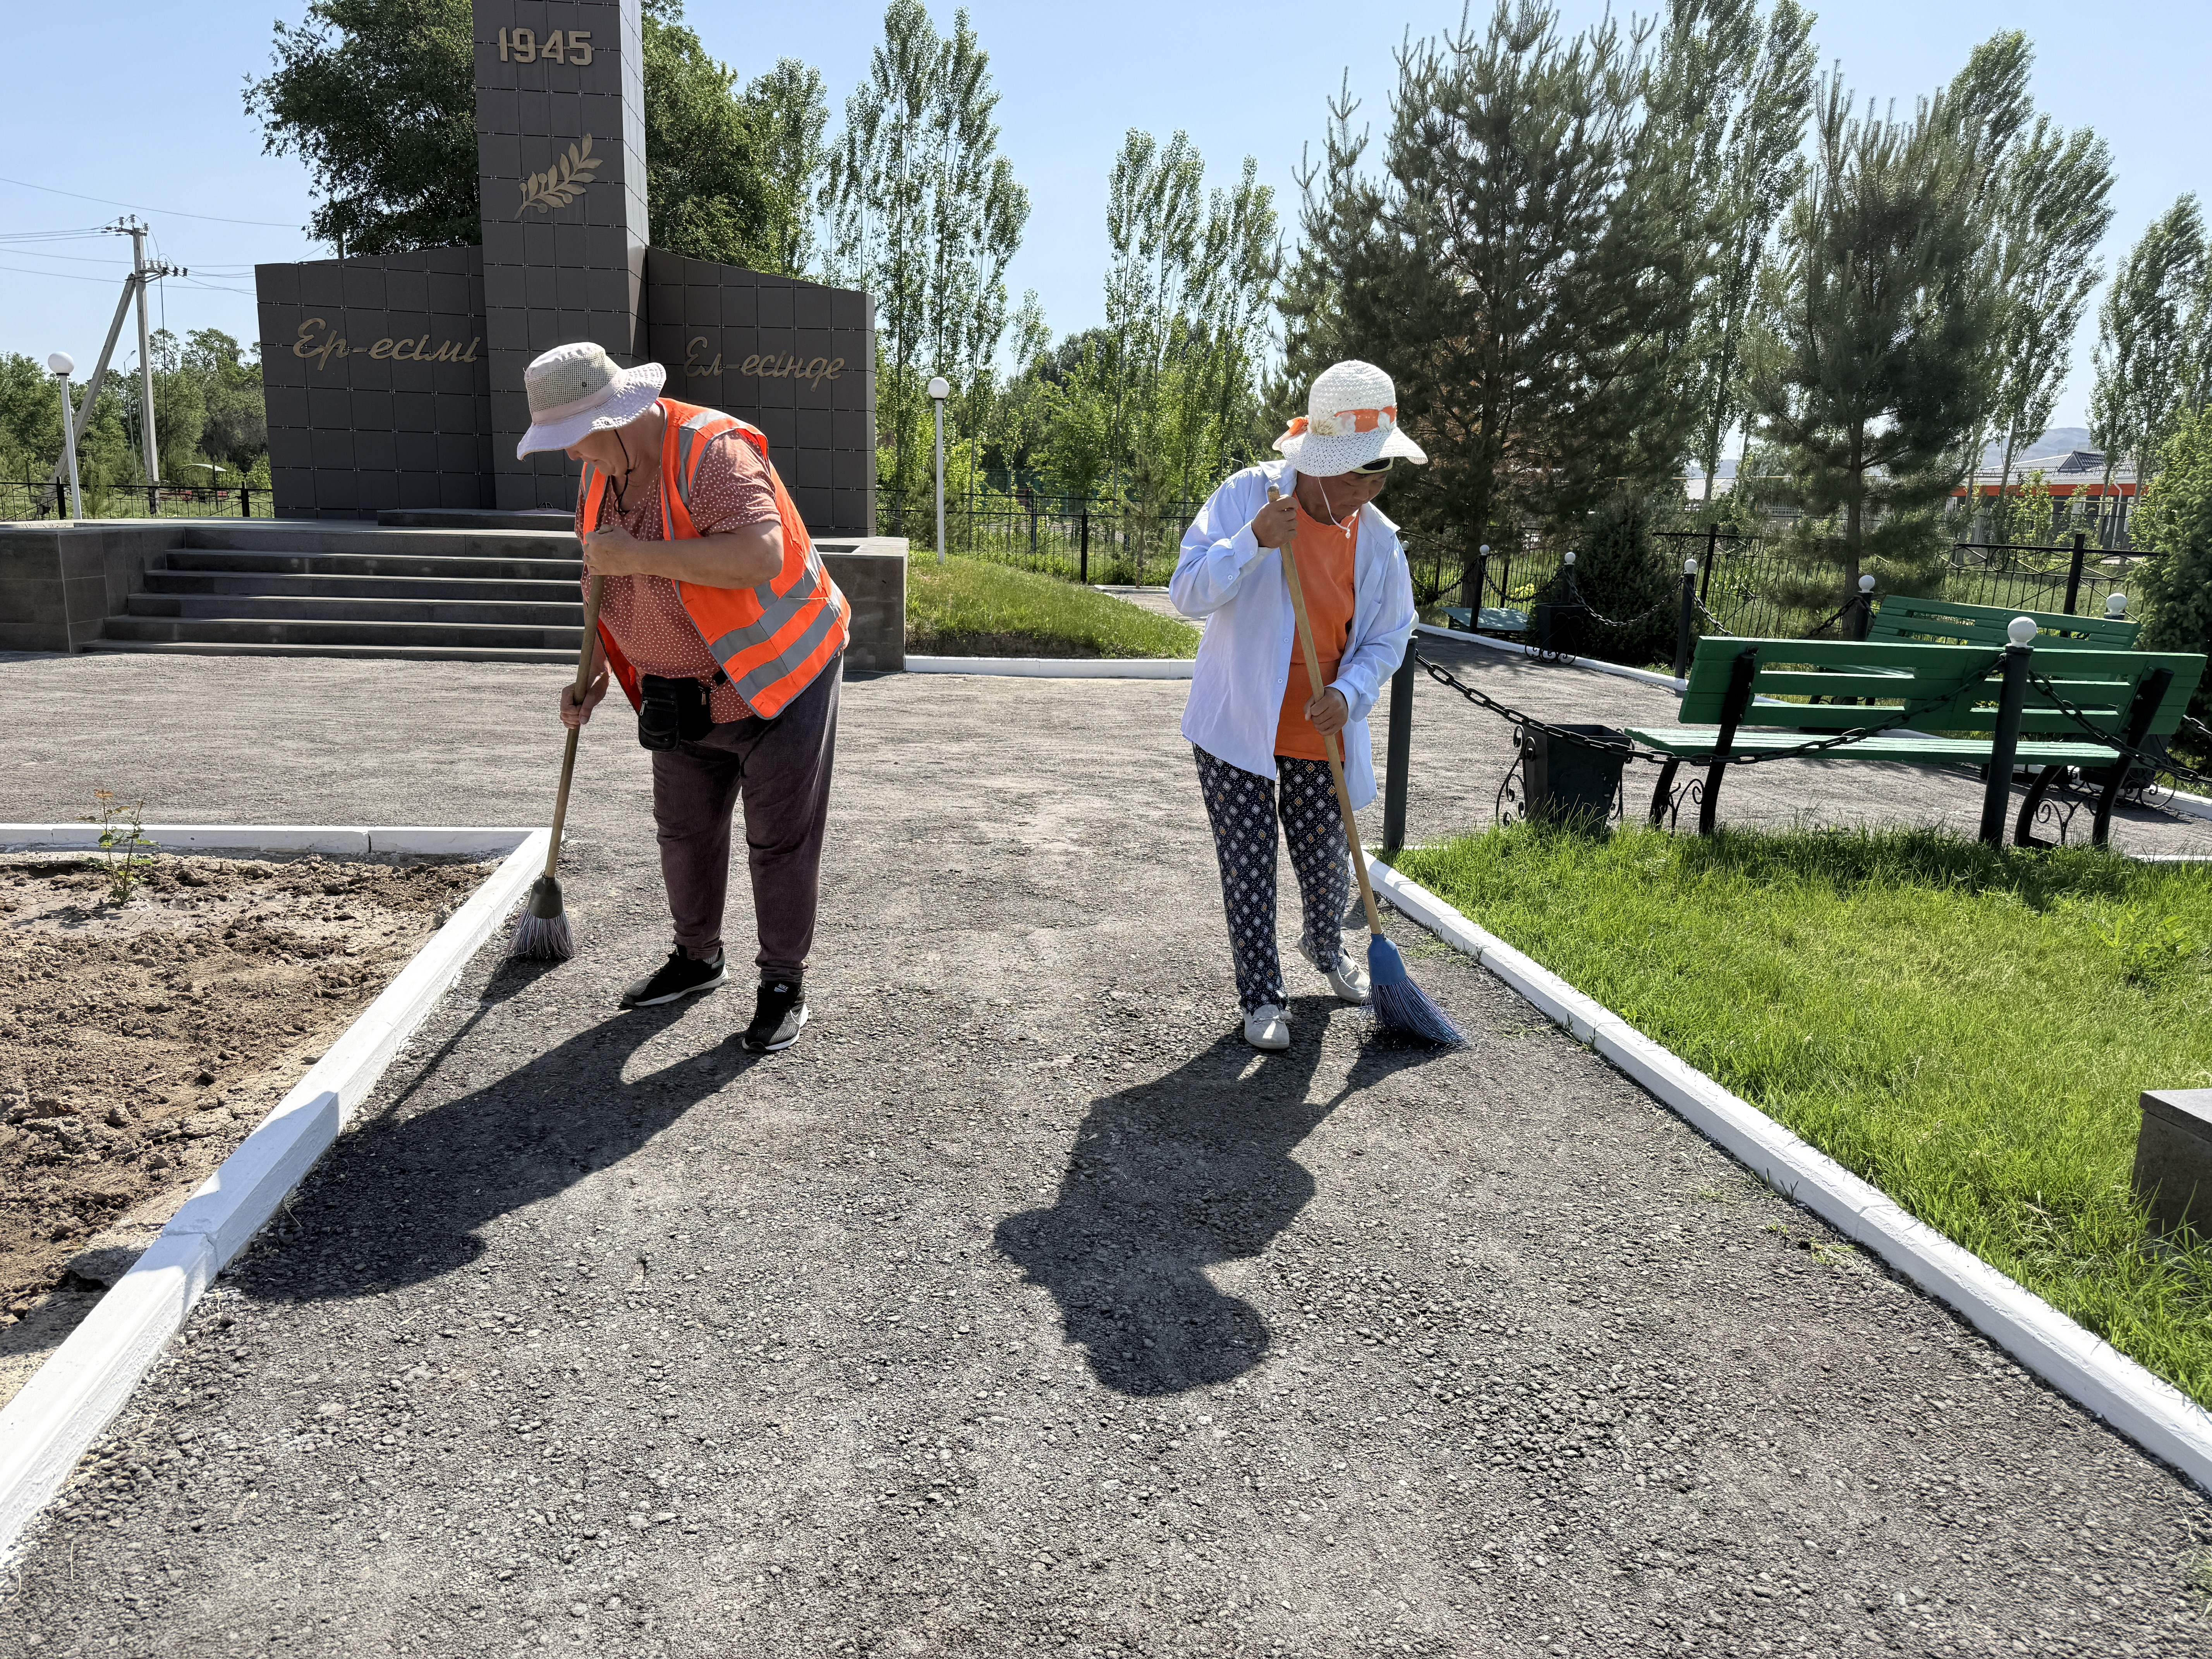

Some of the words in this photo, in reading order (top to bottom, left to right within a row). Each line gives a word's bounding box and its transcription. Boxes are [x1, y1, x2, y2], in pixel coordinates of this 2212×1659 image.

[499, 27, 592, 65] 1945
[293, 318, 481, 371] Ер-есімі
[683, 336, 845, 392] Ел-есінде
